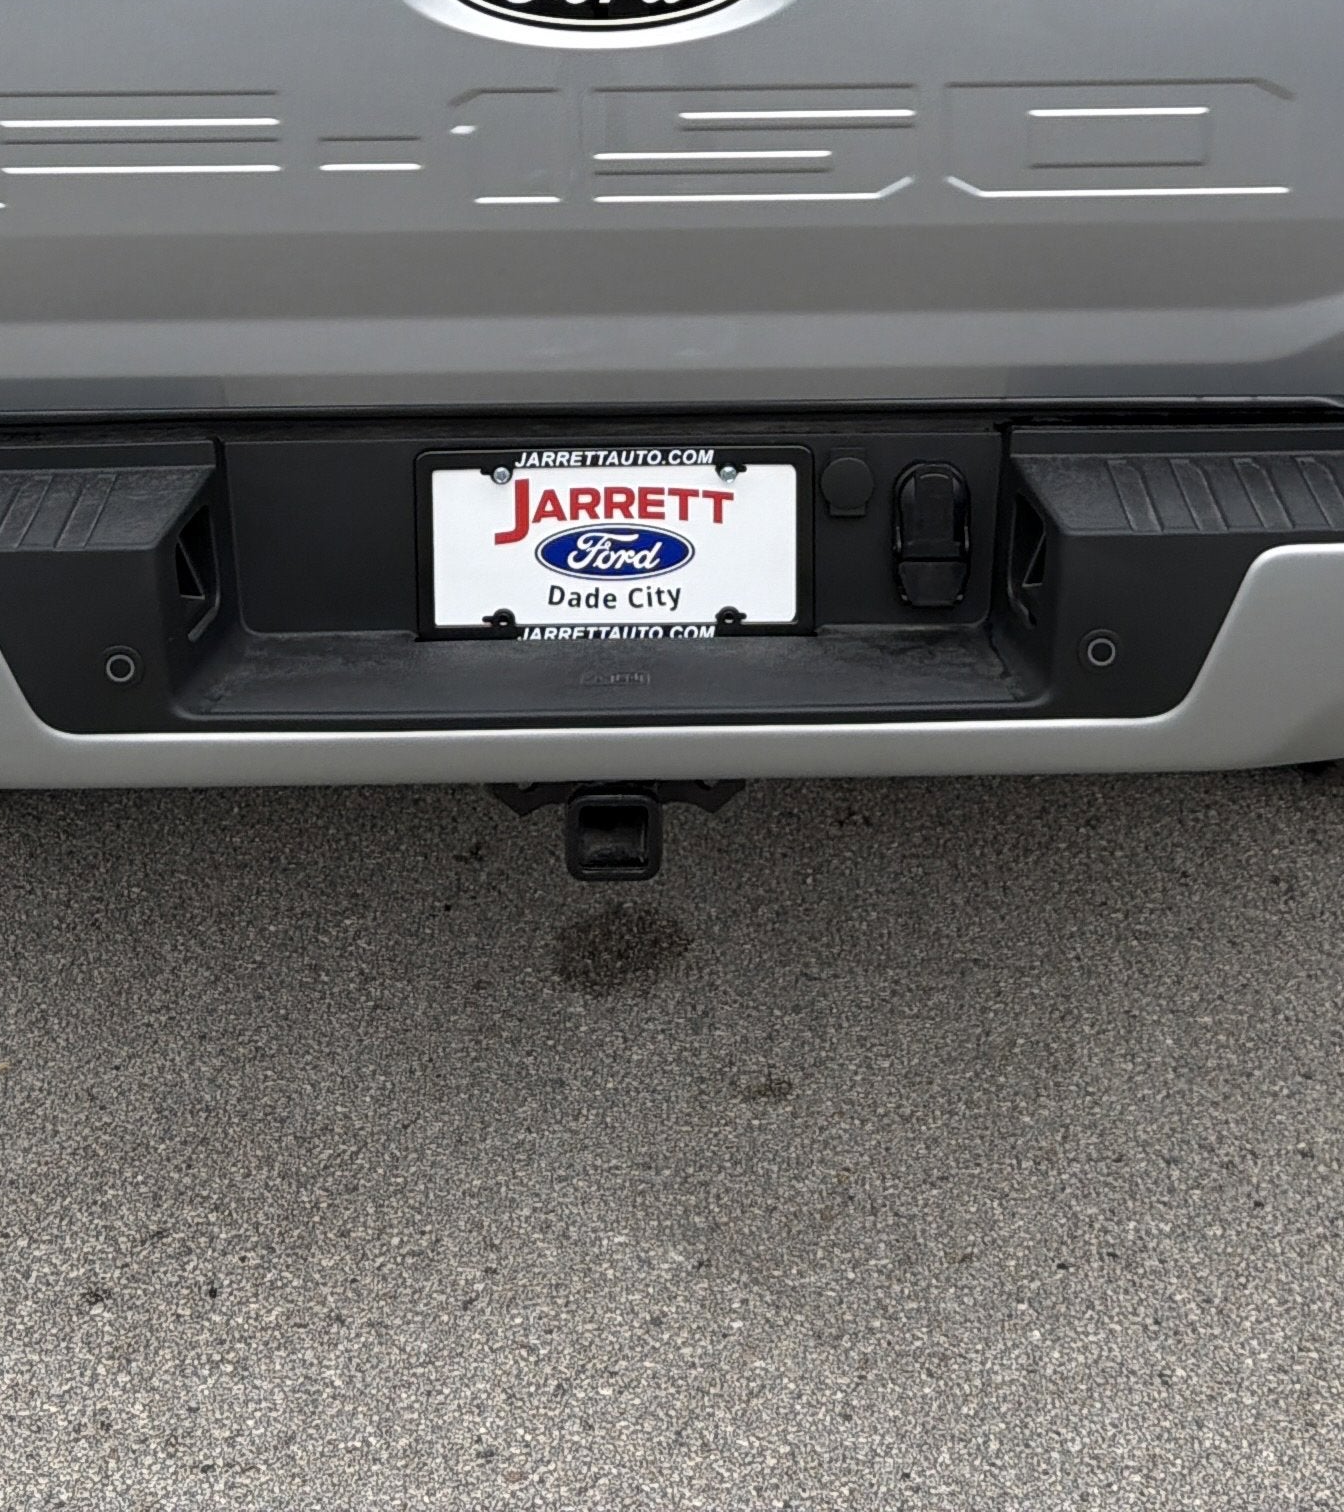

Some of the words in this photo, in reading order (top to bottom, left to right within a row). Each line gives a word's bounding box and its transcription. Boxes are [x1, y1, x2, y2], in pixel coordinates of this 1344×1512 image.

[514, 449, 715, 468] JARRETTAUTO.COM
[495, 478, 734, 545] JARRETT
[566, 532, 664, 570] Ford
[547, 584, 617, 609] Dade
[628, 585, 681, 611] City
[516, 625, 716, 641] JARRETTAUTOCOM
